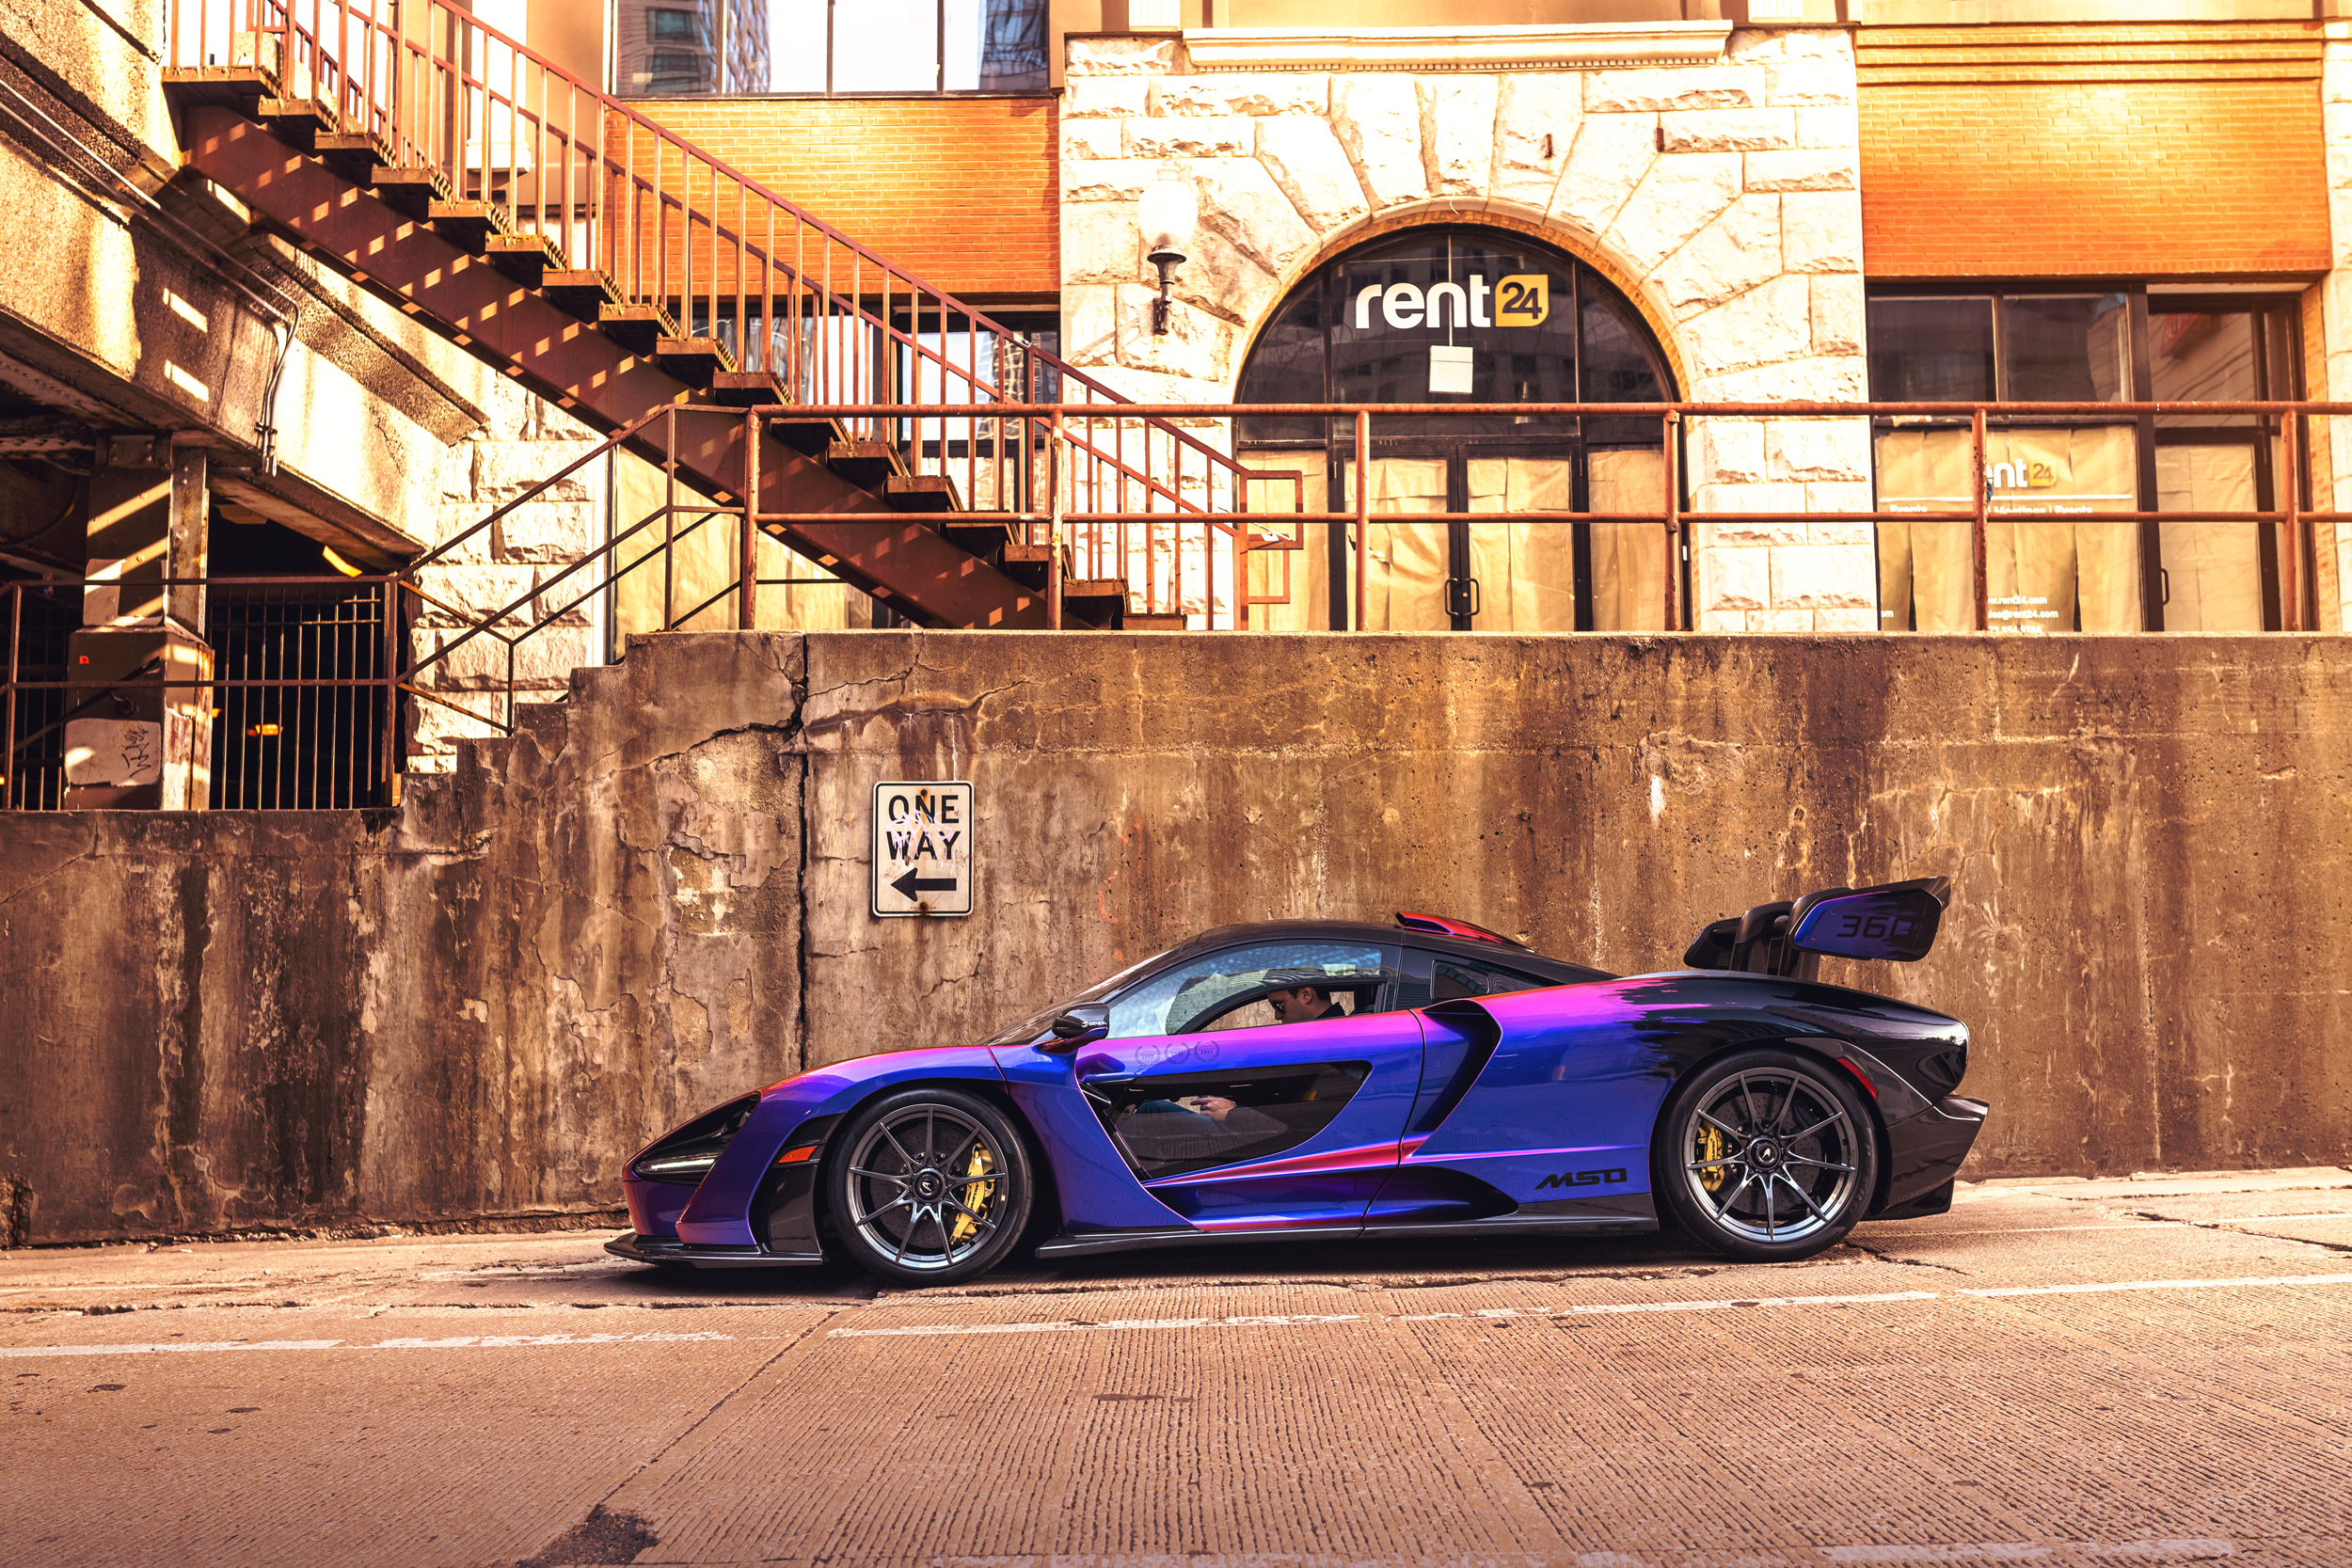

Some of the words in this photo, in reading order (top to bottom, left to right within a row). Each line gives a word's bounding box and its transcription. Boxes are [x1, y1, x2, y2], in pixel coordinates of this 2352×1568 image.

[888, 795, 960, 824] ONE
[886, 831, 961, 861] WAY
[1534, 1167, 1628, 1190] MSO
